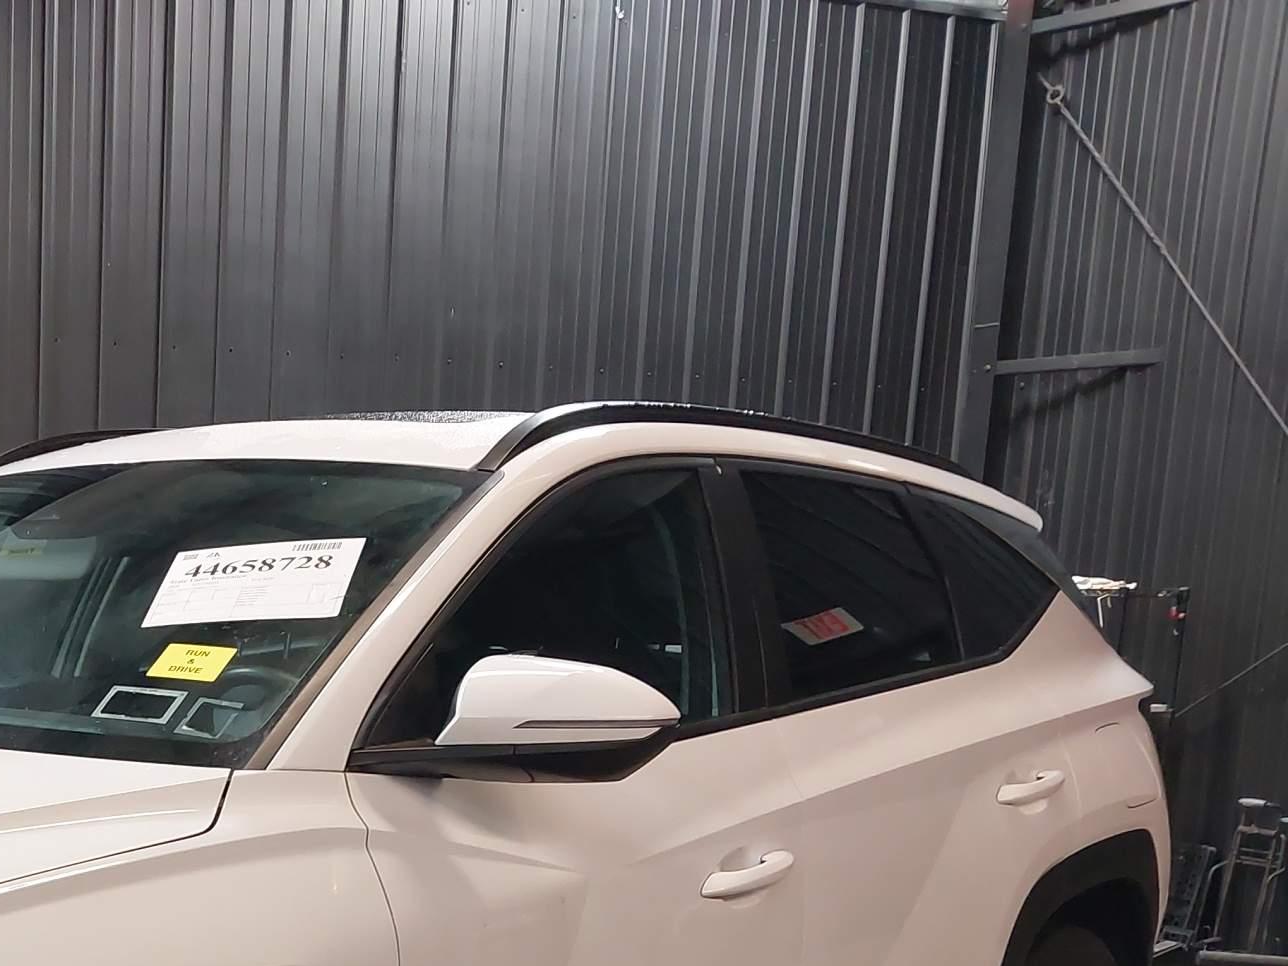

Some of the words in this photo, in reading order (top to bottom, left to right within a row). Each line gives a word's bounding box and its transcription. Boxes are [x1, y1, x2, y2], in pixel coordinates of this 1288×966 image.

[184, 555, 334, 577] 44658728
[185, 649, 211, 657] RUN
[168, 665, 203, 674] DRIVE
